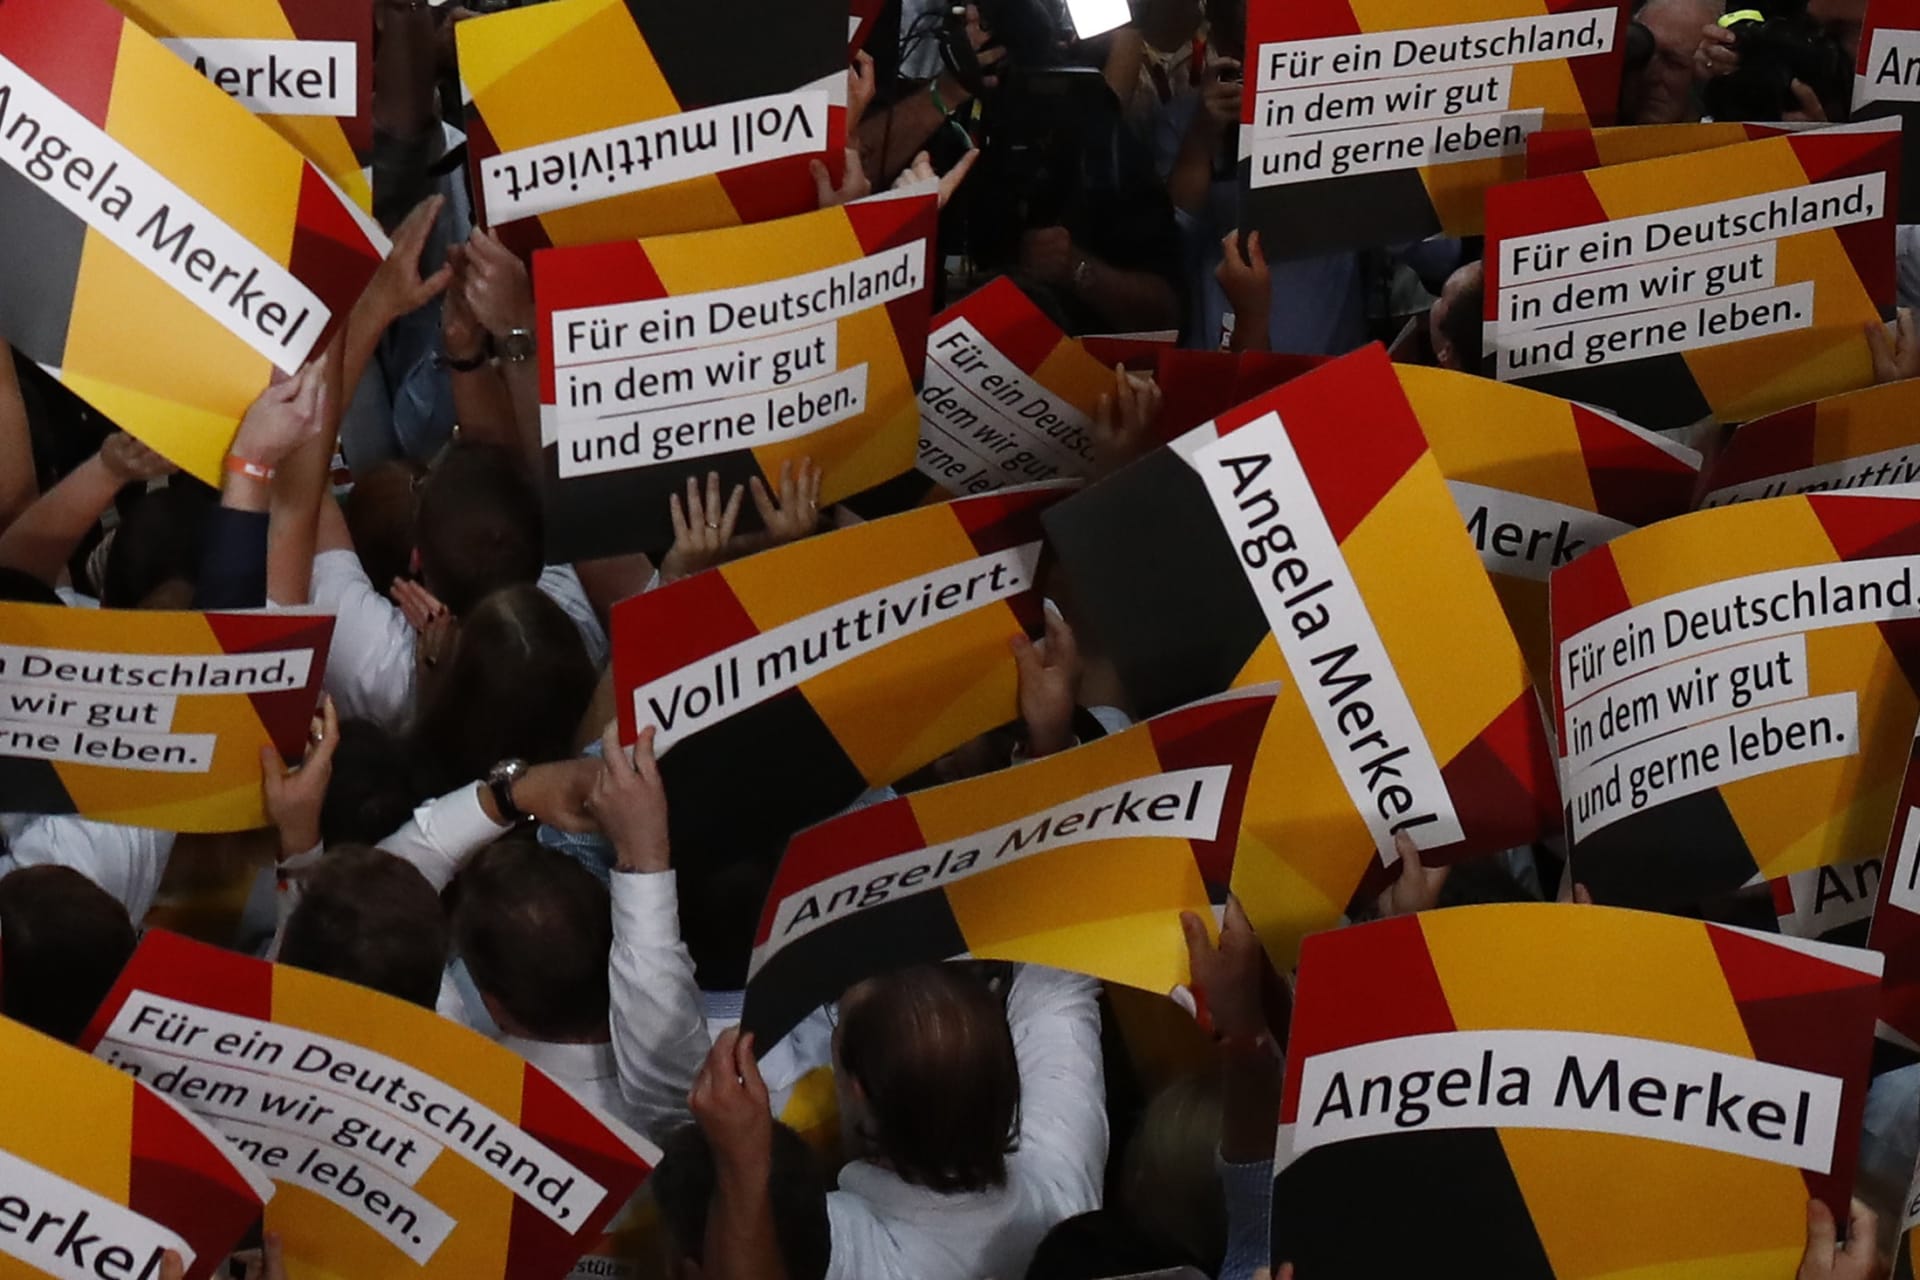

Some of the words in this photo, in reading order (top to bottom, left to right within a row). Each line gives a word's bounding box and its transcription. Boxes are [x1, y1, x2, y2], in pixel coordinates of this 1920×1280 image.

[1270, 50, 1324, 81] Für
[1332, 44, 1381, 73] ein
[1393, 17, 1604, 68] Deutschland,
[733, 104, 813, 155] Voll
[1266, 99, 1294, 127] in
[1304, 93, 1375, 123] dem
[1385, 81, 1437, 113] wir
[1446, 76, 1500, 115] gut
[493, 120, 717, 201] muttiviert.
[1262, 139, 1322, 175] und
[1332, 135, 1424, 175] gerne
[1512, 243, 1569, 275] Für
[1579, 231, 1632, 264] ein
[1645, 183, 1873, 252] Deutschland,
[136, 205, 309, 348] Merkel
[568, 311, 629, 354] Für
[640, 309, 695, 344] ein
[709, 254, 917, 335] Deutschland,
[1511, 294, 1541, 322] in
[1552, 283, 1628, 314] dem
[1640, 266, 1696, 299] wir
[1706, 254, 1764, 296] gut
[569, 376, 601, 408] in
[614, 367, 693, 401] dem
[705, 350, 763, 387] wir
[773, 337, 827, 385] gut
[936, 331, 989, 373] Für
[981, 373, 1024, 405] ein
[1508, 331, 1573, 369] und
[1585, 323, 1686, 364] gerne
[1698, 299, 1802, 337] leben.
[572, 421, 640, 463] und
[652, 411, 756, 459] gerne
[767, 386, 857, 432] leben.
[922, 386, 978, 430] dem
[972, 425, 1018, 455] wir
[22, 655, 296, 688] Deutschland,
[648, 657, 740, 732] Voll
[757, 564, 1020, 687] muttiviert.
[1219, 452, 1334, 640] Angela
[1310, 643, 1438, 836] Merkel
[1568, 643, 1606, 691] Für
[1612, 622, 1655, 667] ein
[11, 692, 78, 716] wir
[87, 702, 159, 727] gut
[1573, 717, 1594, 756] in
[1599, 697, 1659, 740] dem
[1667, 668, 1720, 715] wir
[1730, 650, 1793, 708] gut
[74, 732, 198, 765] leben.
[1578, 763, 1621, 824] und
[1630, 742, 1720, 809] gerne
[1729, 716, 1846, 766] leben.
[784, 845, 981, 935] Angela
[994, 780, 1204, 858] Merkel
[128, 1005, 208, 1046] Für
[213, 1031, 284, 1065] ein
[292, 1044, 575, 1219] Deutschland,
[151, 1065, 249, 1108] dem
[260, 1090, 335, 1125] wir
[331, 1115, 419, 1169] gut
[1313, 1050, 1531, 1128] Angela
[1553, 1054, 1811, 1147] Merkel
[297, 1146, 422, 1245] leben.
